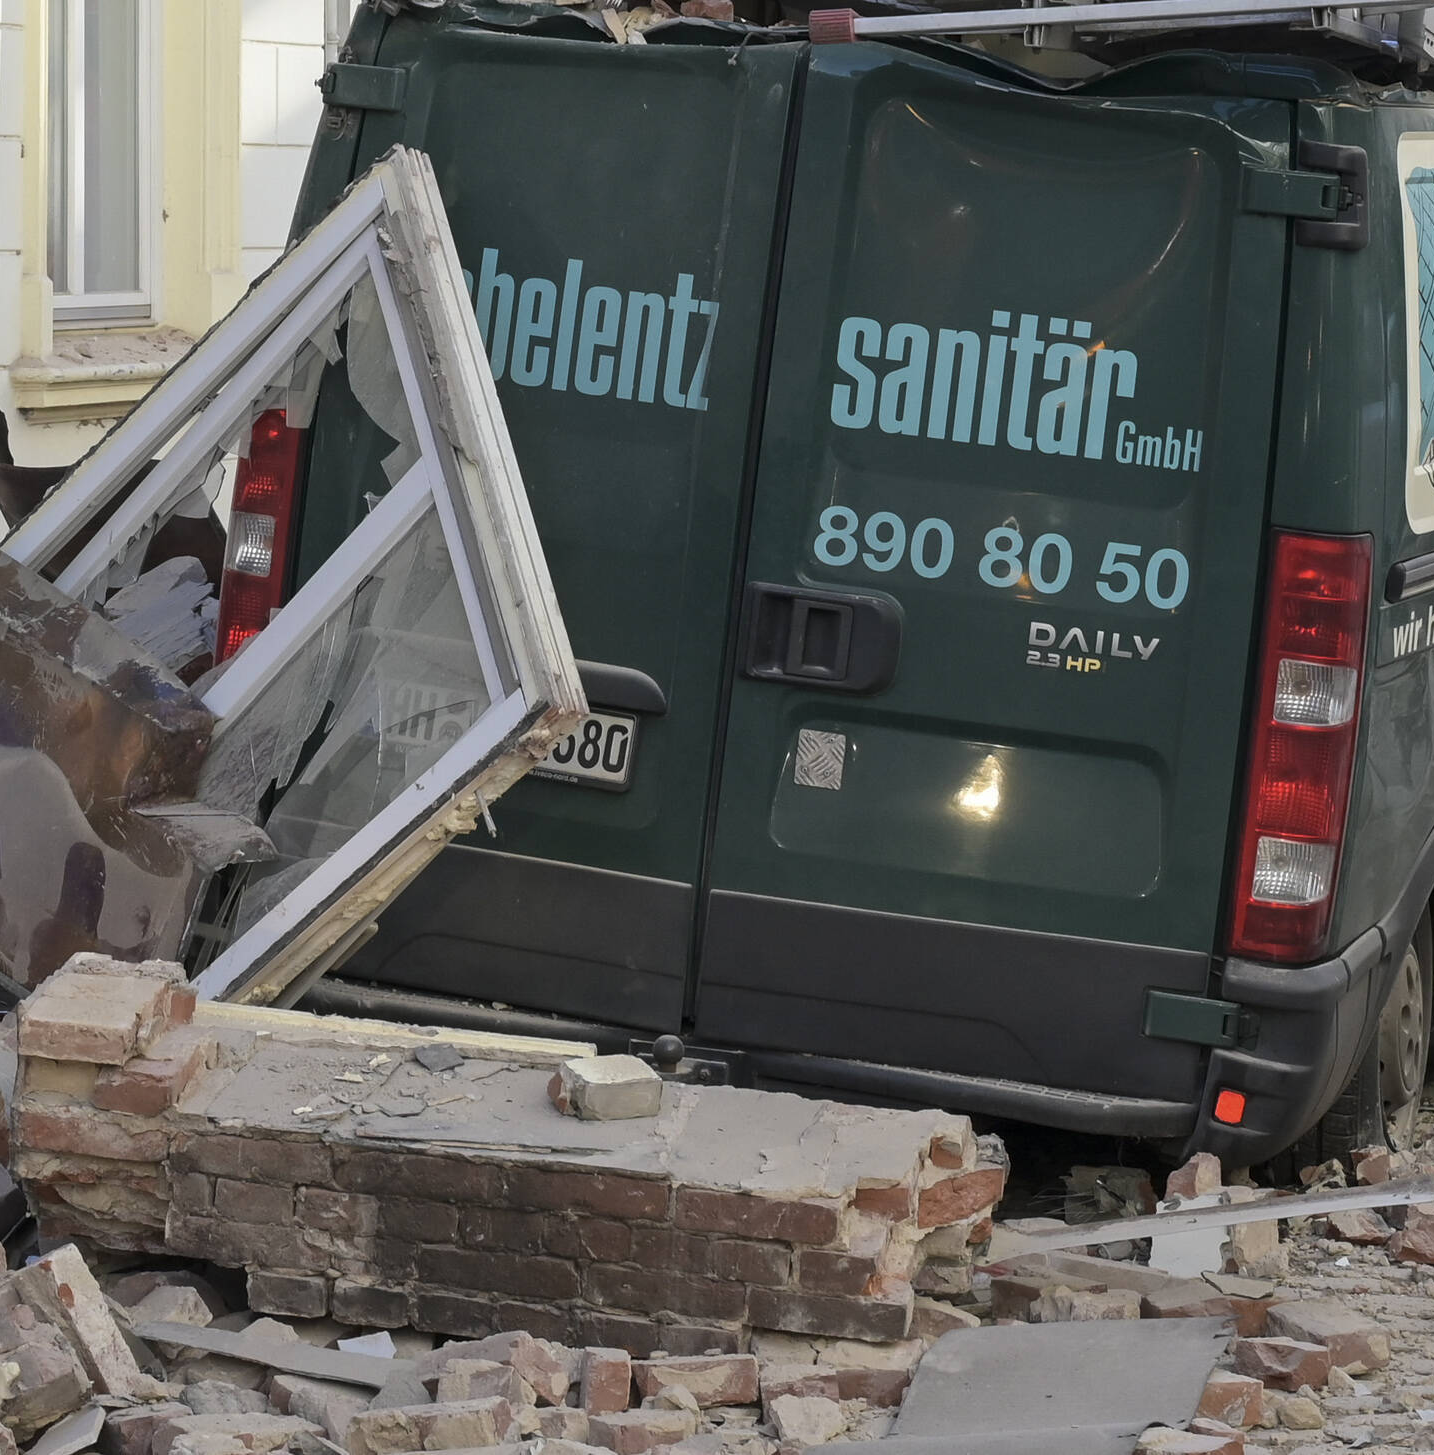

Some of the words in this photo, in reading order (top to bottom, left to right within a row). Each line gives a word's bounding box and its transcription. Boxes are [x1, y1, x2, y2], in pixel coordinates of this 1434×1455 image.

[830, 309, 1139, 461] sanitär
[1115, 420, 1204, 473] GmbH
[813, 505, 955, 579] 890
[978, 527, 1073, 595] 80
[1095, 541, 1190, 610] 50
[1027, 621, 1160, 661] DAILY
[1393, 611, 1423, 658] wir
[1025, 650, 1062, 668] 2.3
